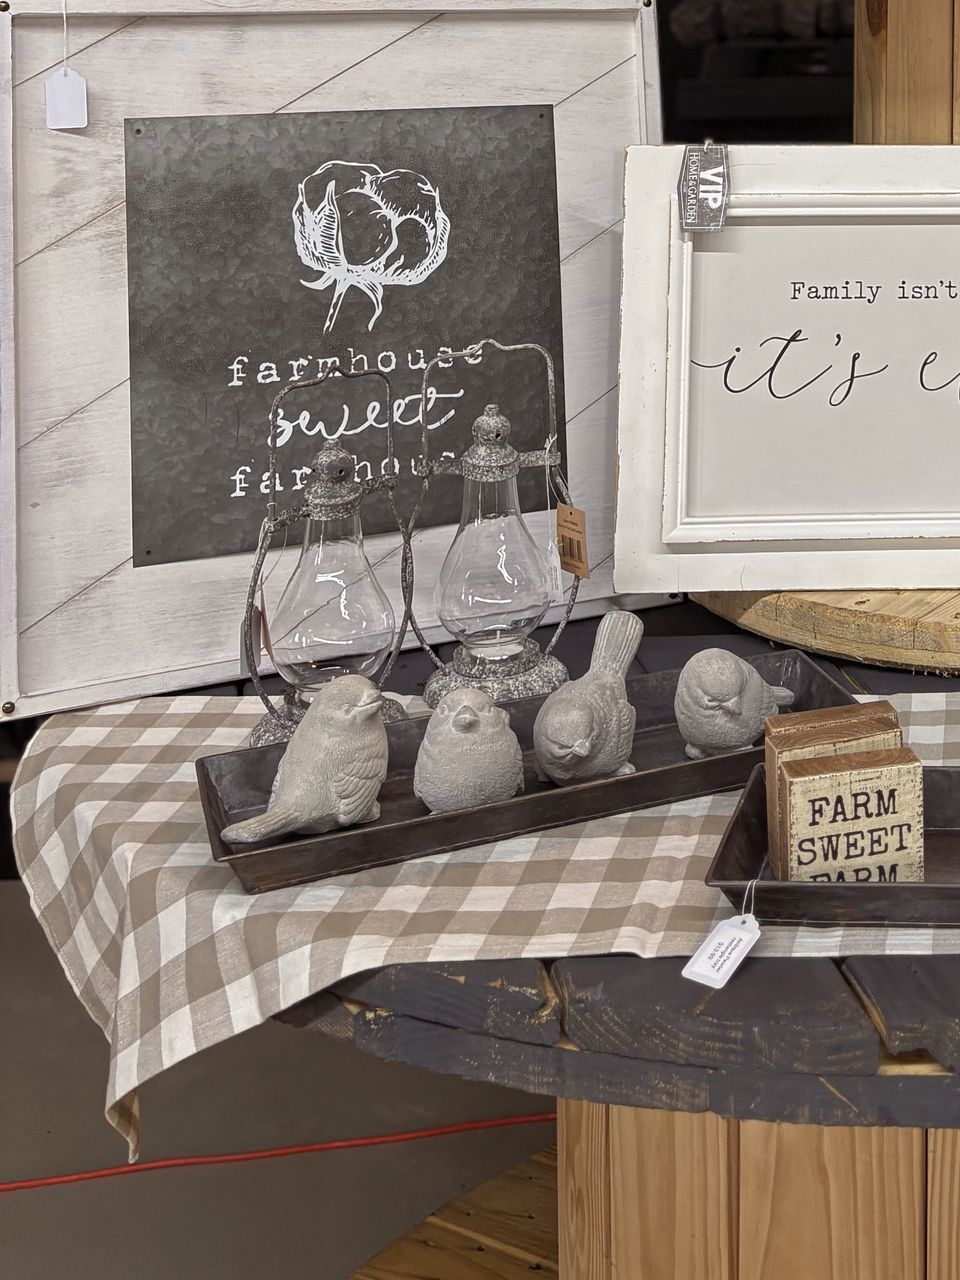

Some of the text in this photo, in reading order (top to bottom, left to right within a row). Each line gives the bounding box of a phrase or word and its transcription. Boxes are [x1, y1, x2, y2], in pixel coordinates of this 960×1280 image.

[699, 165, 723, 209] VIP
[790, 280, 882, 303] Family
[897, 280, 958, 300] isn't
[227, 342, 483, 387] farmhouse
[690, 329, 889, 407] it's
[267, 386, 464, 447] sweet
[808, 788, 899, 827] FARM
[797, 823, 912, 866] SWEET
